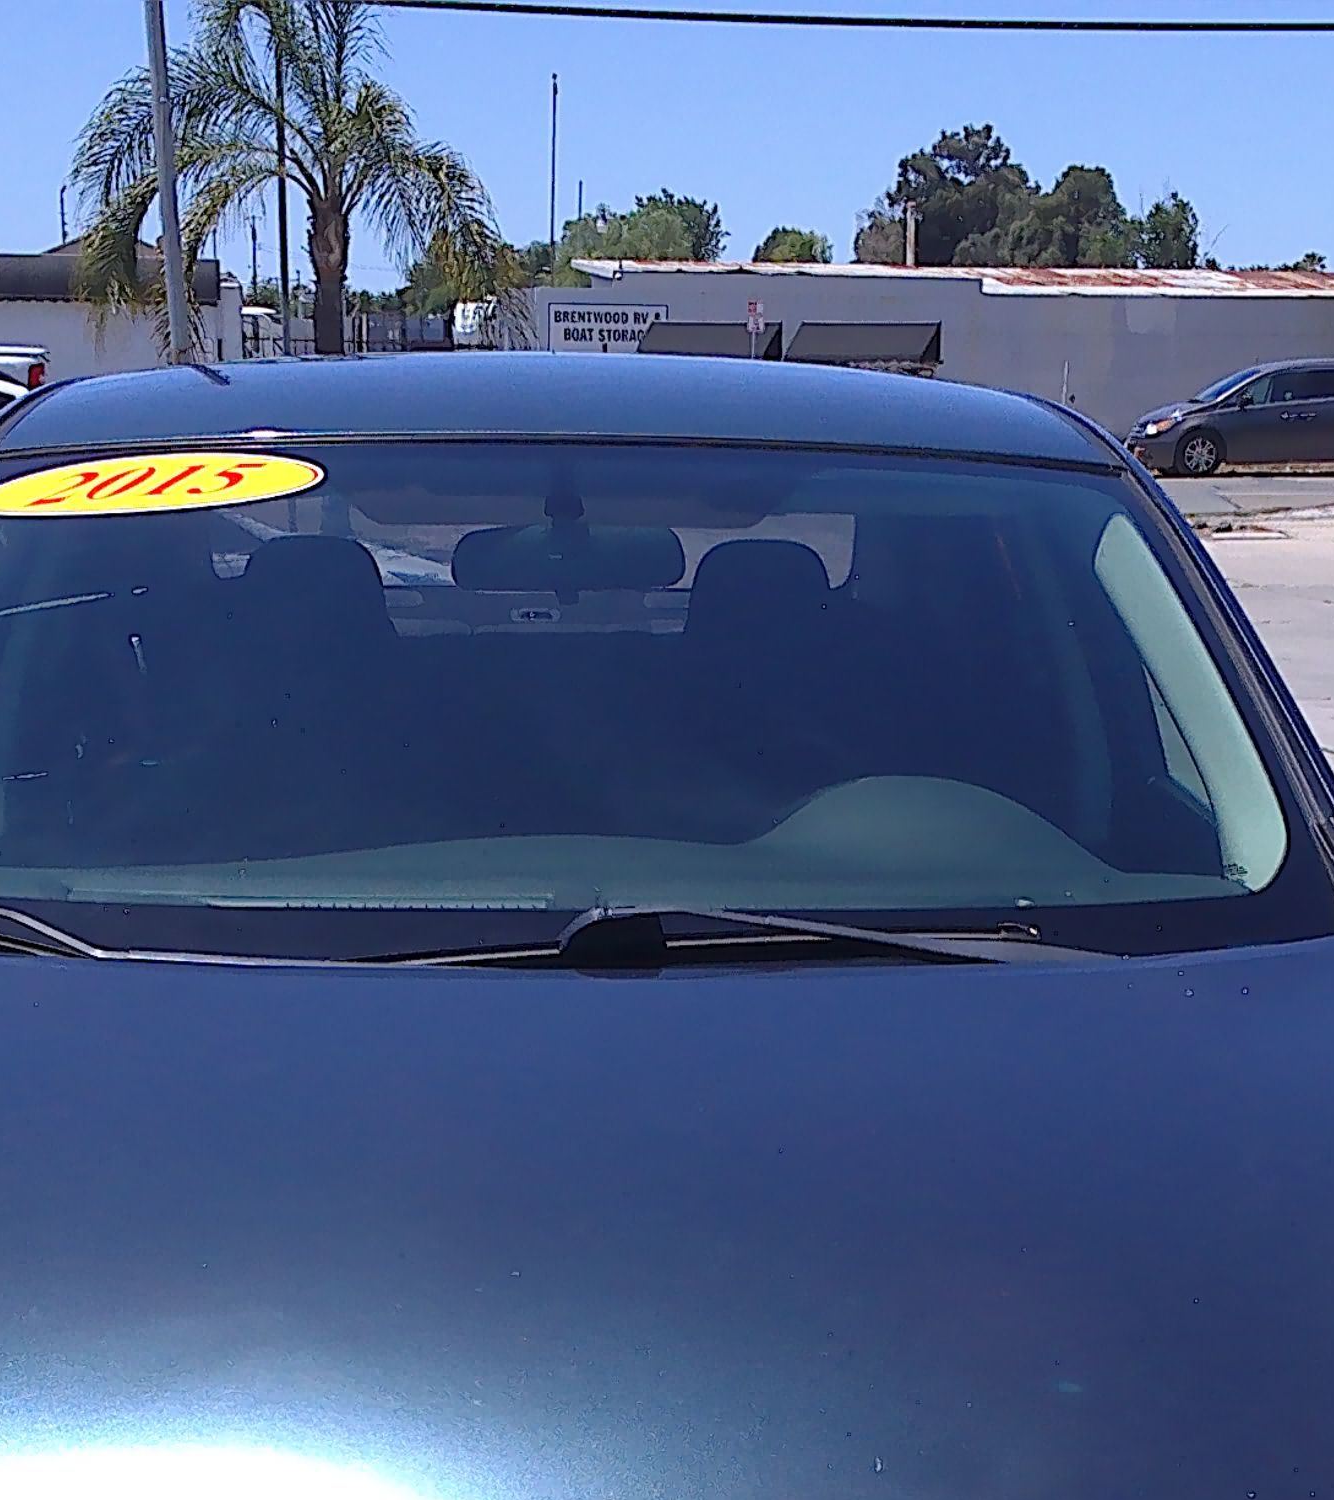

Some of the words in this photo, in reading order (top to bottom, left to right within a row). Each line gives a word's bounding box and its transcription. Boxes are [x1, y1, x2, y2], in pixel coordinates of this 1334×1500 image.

[554, 310, 629, 324] BRENTWOOD
[633, 311, 649, 325] RV
[564, 328, 594, 342] BOAT
[24, 463, 267, 507] 2015
